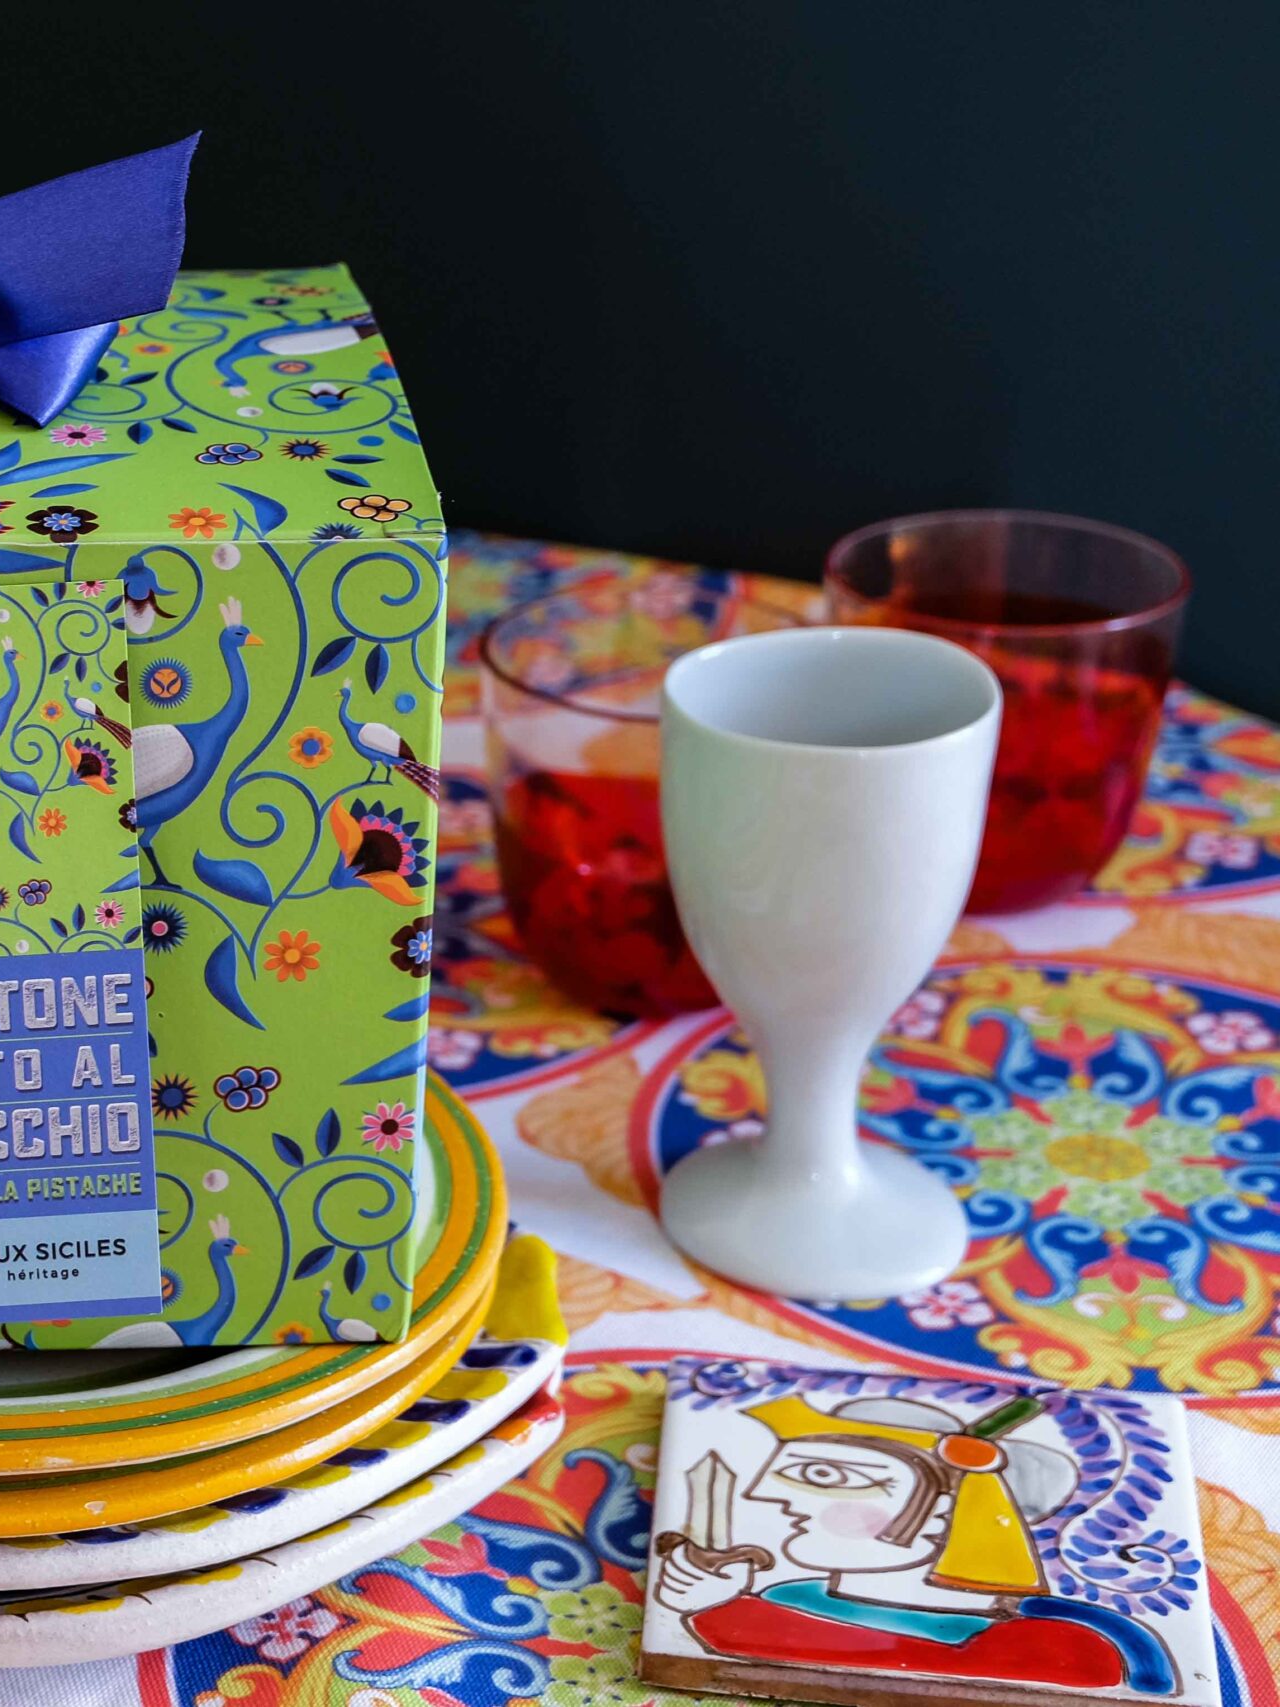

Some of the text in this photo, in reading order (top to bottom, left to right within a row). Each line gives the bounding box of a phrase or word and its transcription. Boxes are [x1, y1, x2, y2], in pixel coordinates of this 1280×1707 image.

[72, 1043, 135, 1088] AL
[27, 1173, 141, 1200] PISTACHE
[36, 1239, 126, 1260] SICILES
[7, 1266, 79, 1283] héritage
